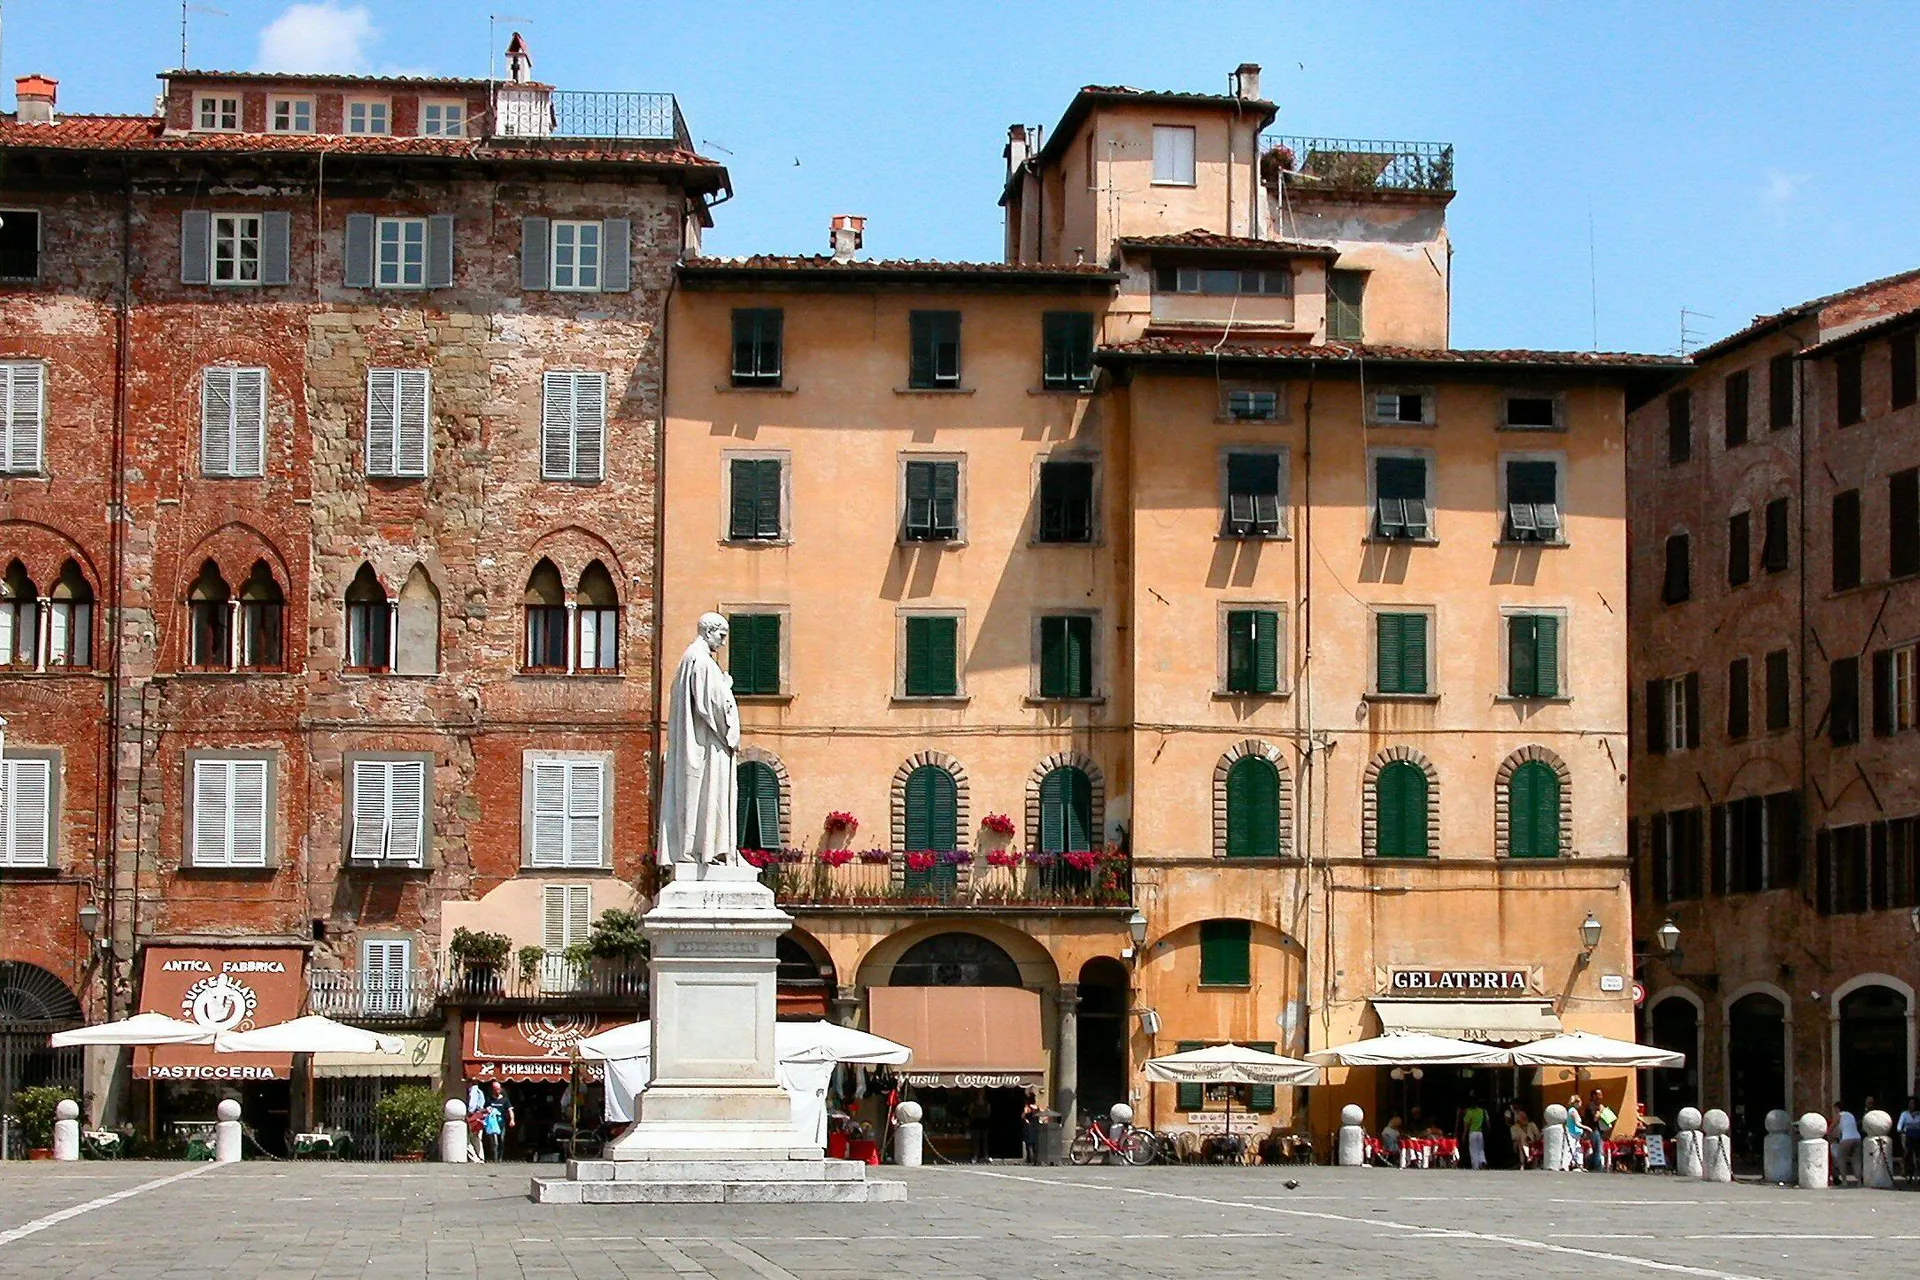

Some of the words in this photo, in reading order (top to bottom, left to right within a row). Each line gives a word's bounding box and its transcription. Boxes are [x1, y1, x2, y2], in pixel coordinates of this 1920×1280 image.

[162, 960, 212, 972] ANTICA
[222, 961, 286, 973] FABBRICA
[1394, 971, 1526, 989] GELATERIA
[180, 974, 258, 1009] BUCCELLATO
[1463, 1029, 1488, 1039] BAR
[148, 1066, 275, 1078] PASTICCERIA
[501, 1063, 563, 1075] FARMACIA
[954, 1073, 1021, 1085] Costantino
